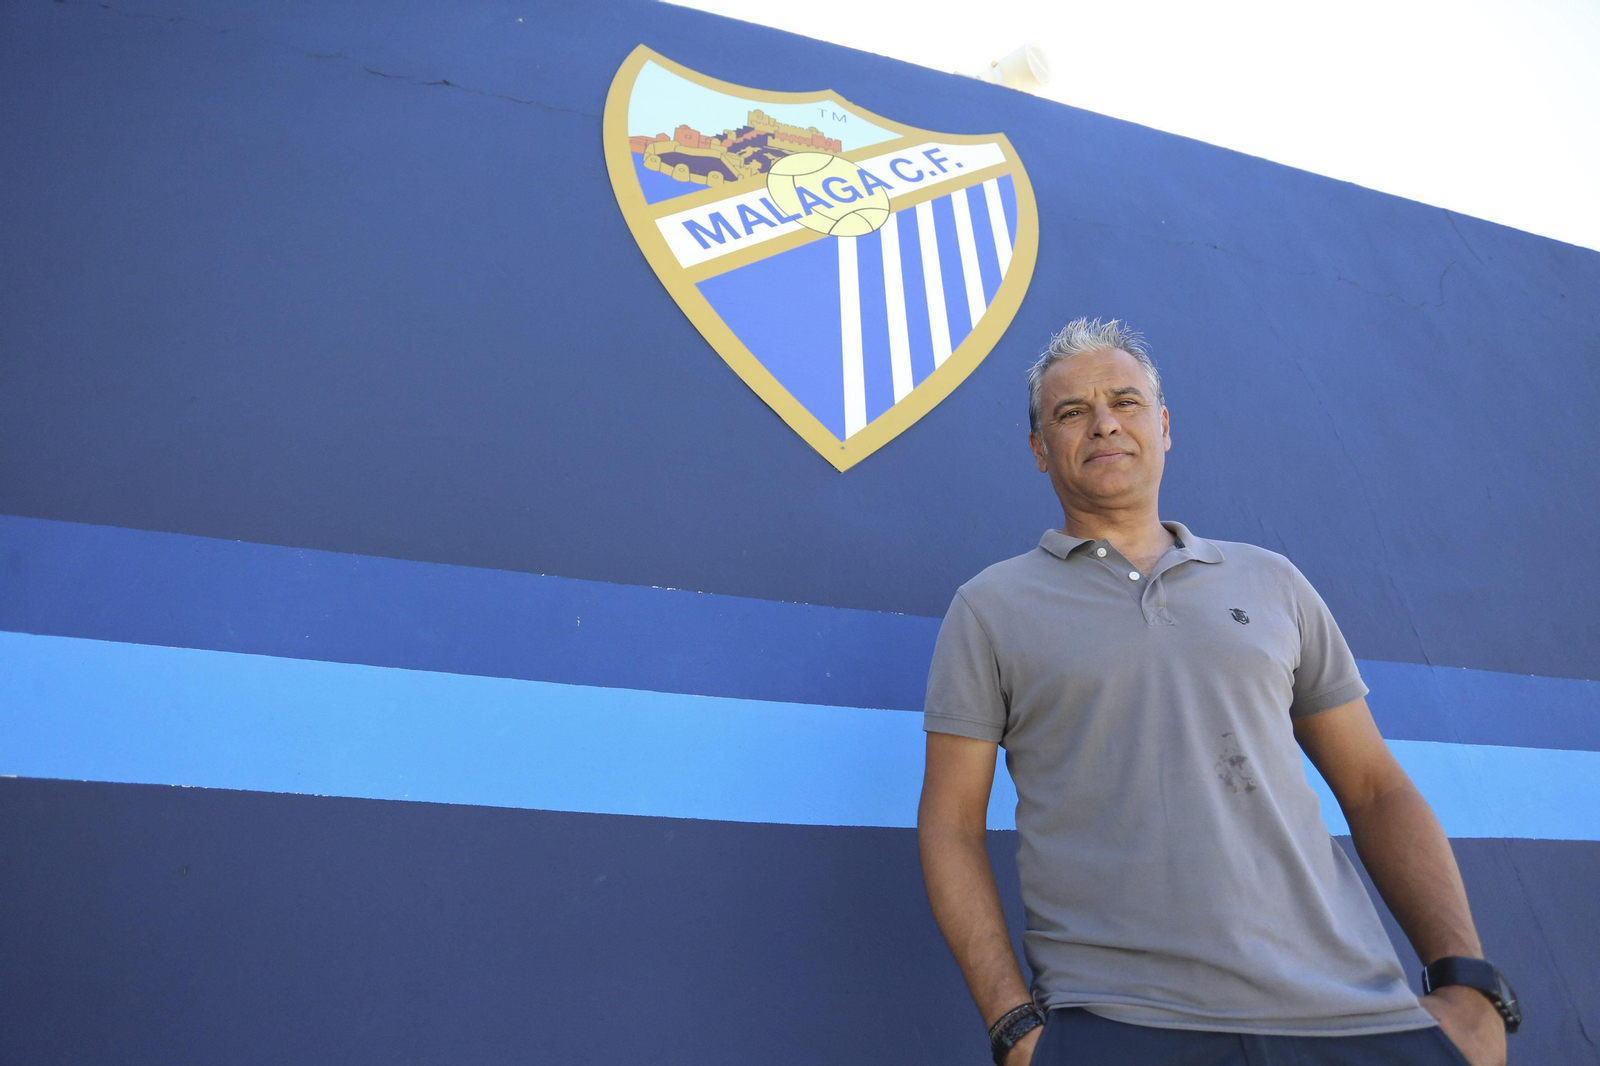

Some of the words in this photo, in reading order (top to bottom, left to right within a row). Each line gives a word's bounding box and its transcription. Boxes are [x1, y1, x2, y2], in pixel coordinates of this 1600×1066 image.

[816, 107, 848, 124] TM
[681, 168, 894, 250] MALAGA
[889, 147, 964, 183] C.F.
